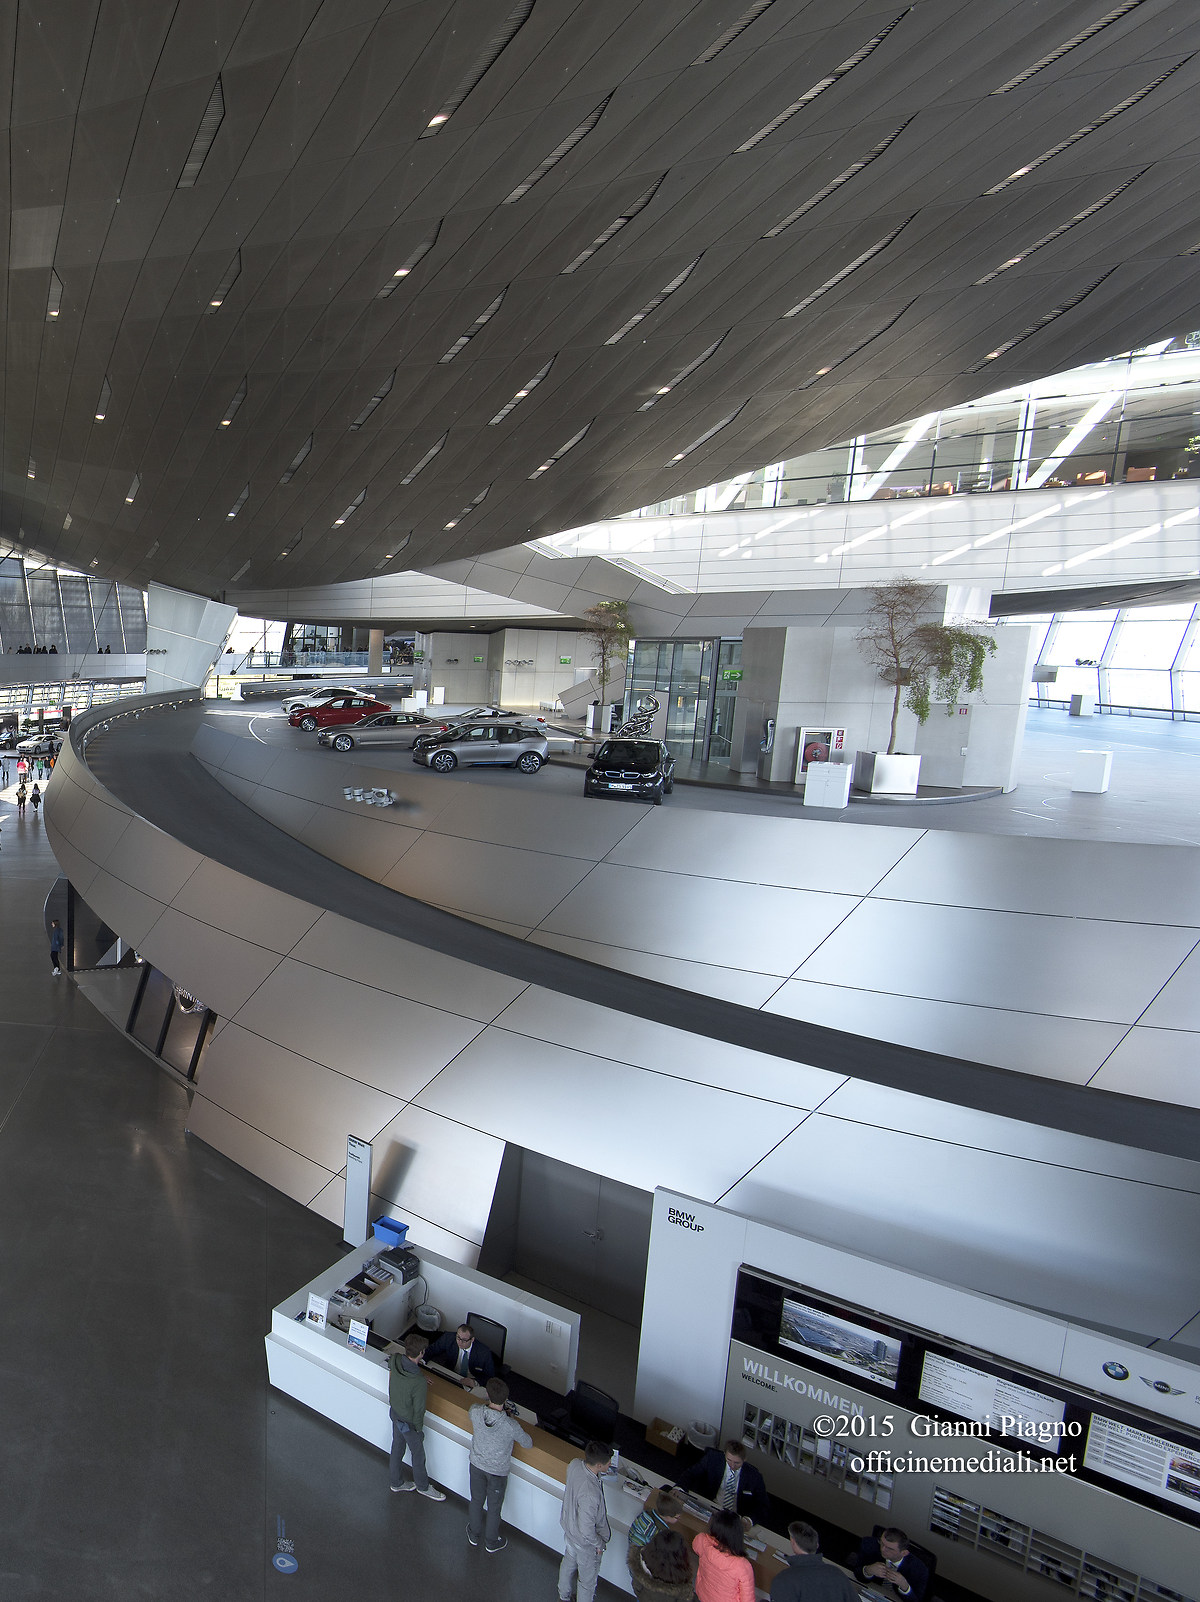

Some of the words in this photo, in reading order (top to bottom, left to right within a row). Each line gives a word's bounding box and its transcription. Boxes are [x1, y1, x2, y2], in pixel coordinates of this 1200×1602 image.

[667, 1215, 705, 1232] GROUP
[668, 1207, 696, 1223] BMW
[741, 1372, 778, 1393] WELCOME.
